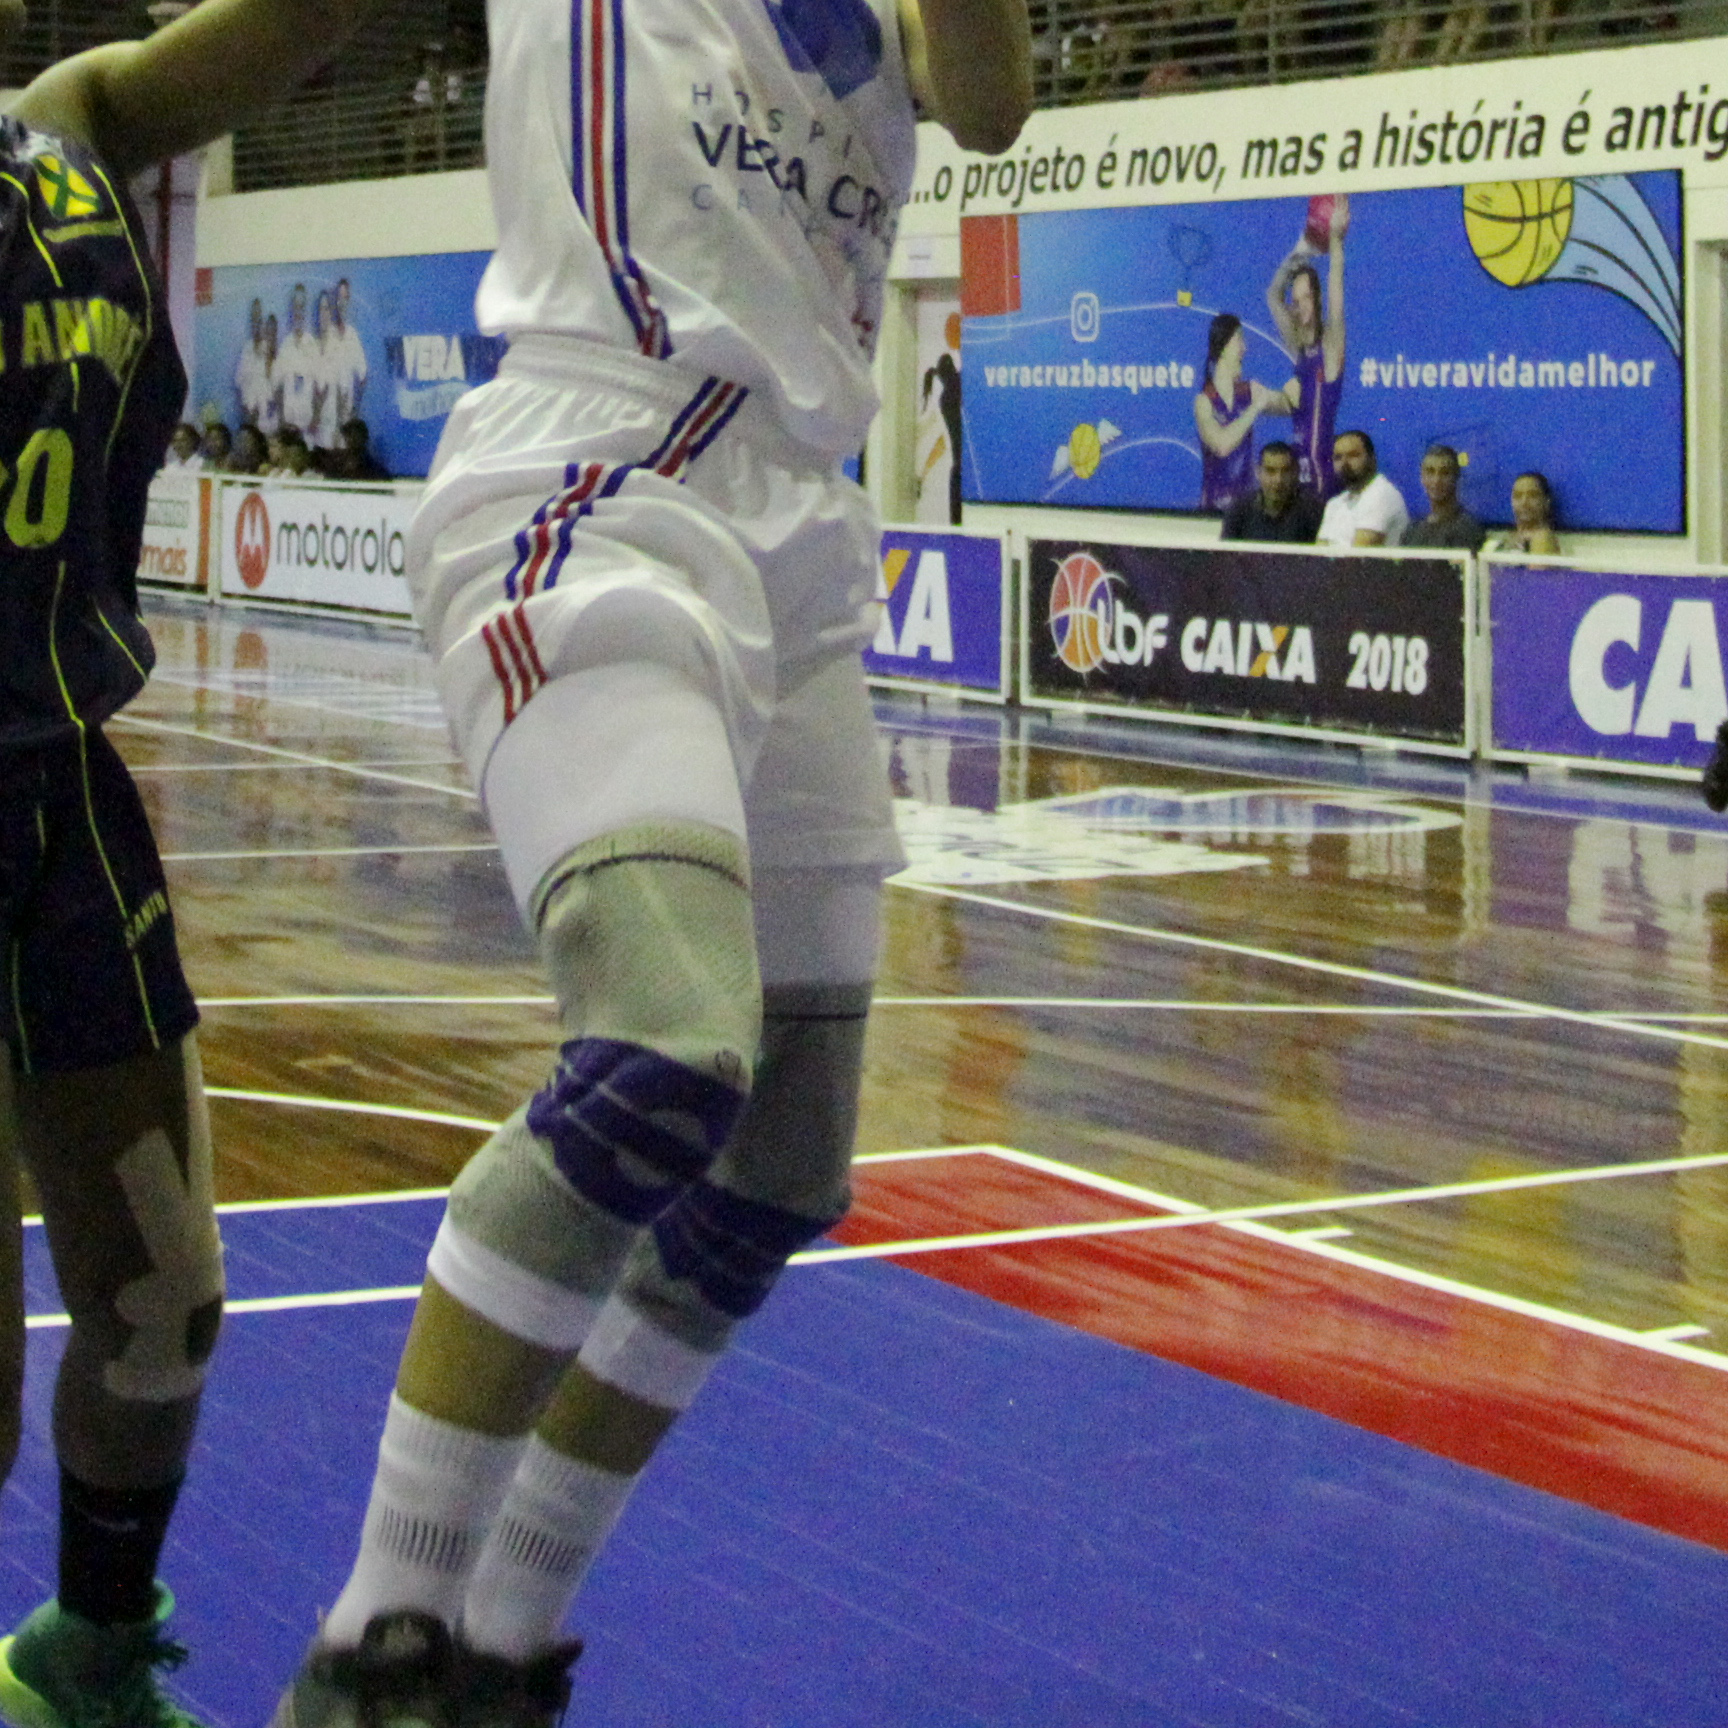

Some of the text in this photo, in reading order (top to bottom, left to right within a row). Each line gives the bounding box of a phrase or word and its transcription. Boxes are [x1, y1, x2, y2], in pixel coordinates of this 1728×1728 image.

[959, 144, 1086, 213] projeto
[1096, 132, 1119, 190] é
[1125, 140, 1226, 194] novo,
[1240, 129, 1327, 180] mas
[1336, 129, 1364, 173] a
[1371, 98, 1546, 169] história
[1561, 88, 1592, 156] é
[983, 358, 1195, 396] veracruzbasquete
[1359, 351, 1657, 391] #viveravidamelhor
[277, 512, 406, 578] motorola
[1179, 616, 1316, 684] CAIXA
[1345, 630, 1430, 696] 2018
